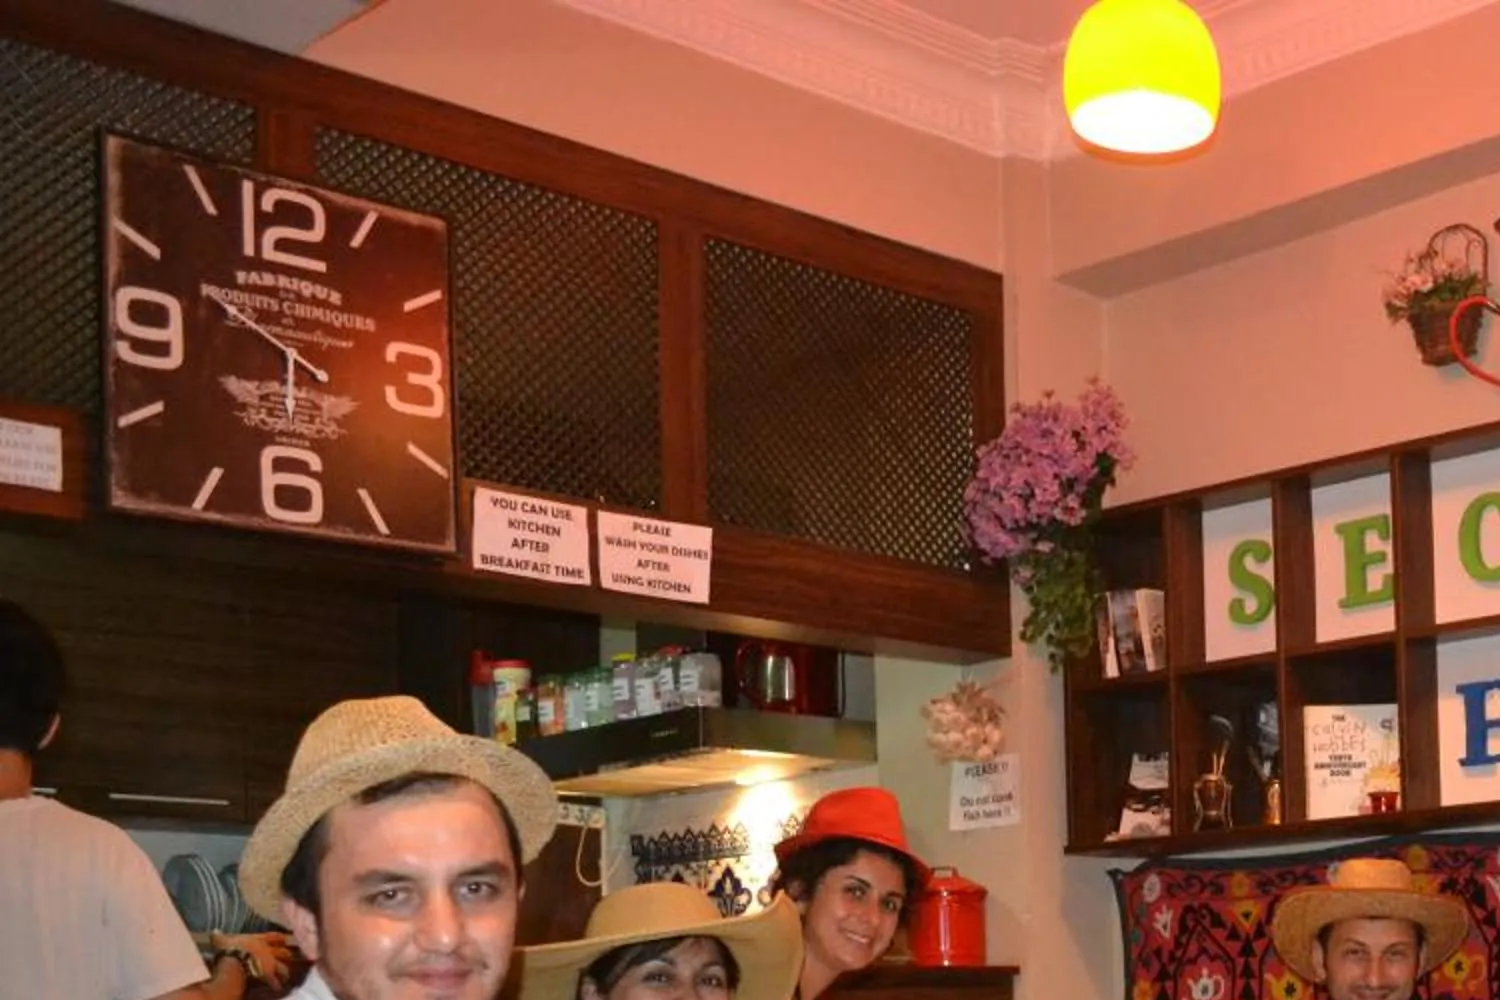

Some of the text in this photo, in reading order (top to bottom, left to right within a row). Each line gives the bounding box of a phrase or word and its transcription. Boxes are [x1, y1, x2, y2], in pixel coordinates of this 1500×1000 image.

[242, 179, 328, 273] 12
[235, 270, 343, 306] FABRIQUE
[115, 285, 184, 371] 9
[281, 300, 377, 333] CHIMIQUES
[384, 341, 445, 418] 3
[260, 445, 323, 524] 6
[489, 497, 573, 521] YOU CAN USE
[507, 517, 561, 537] KITCHEN
[632, 521, 672, 537] PLEASE
[510, 537, 550, 553] AFTER
[605, 536, 637, 550] WASH
[639, 540, 669, 555] YOUR
[479, 553, 585, 579] BREAKFAST TIME
[636, 557, 671, 572] AFTER
[611, 571, 692, 595] USING KITCHEN
